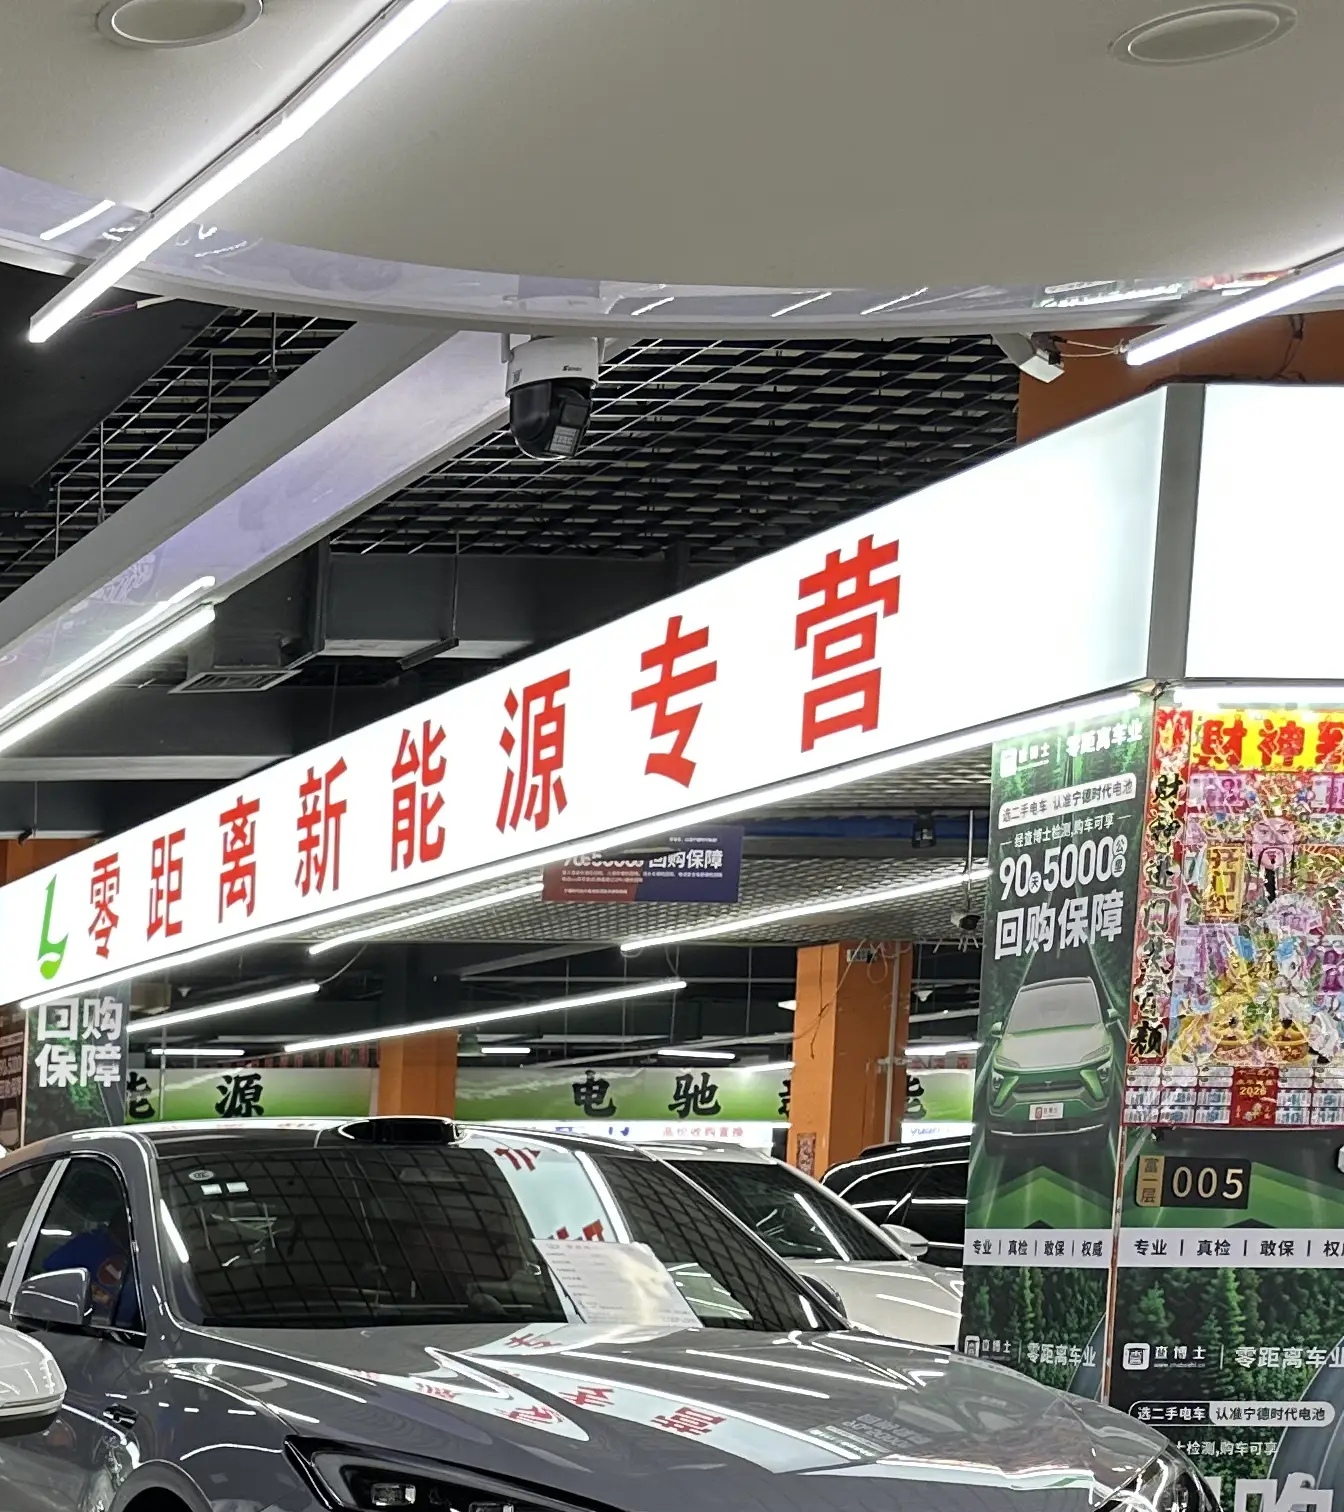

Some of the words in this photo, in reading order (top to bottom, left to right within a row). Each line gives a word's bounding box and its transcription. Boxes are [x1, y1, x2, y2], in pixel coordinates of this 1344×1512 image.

[84, 533, 903, 960] 零距离新能源专营
[994, 888, 1124, 960] 回购保障
[36, 996, 123, 1041] 回购
[35, 1043, 122, 1088] 保障
[571, 1069, 791, 1119] 电驰
[1171, 1165, 1244, 1200] 005
[972, 1240, 993, 1255] 专业
[1007, 1240, 1028, 1256] 真检
[1043, 1240, 1065, 1257] 敢保
[1081, 1240, 1103, 1257] 权威
[1133, 1239, 1168, 1257] 专业
[1196, 1239, 1231, 1257] 真检
[1259, 1240, 1295, 1257] 敢保
[1322, 1240, 1344, 1258] 权
[1026, 1341, 1097, 1368] 零距离车业
[1154, 1344, 1207, 1361] 查博士
[1234, 1345, 1344, 1369] 零距离车业
[1137, 1406, 1206, 1422] 选二手电车
[1215, 1406, 1326, 1421] 认准宁德时代电池
